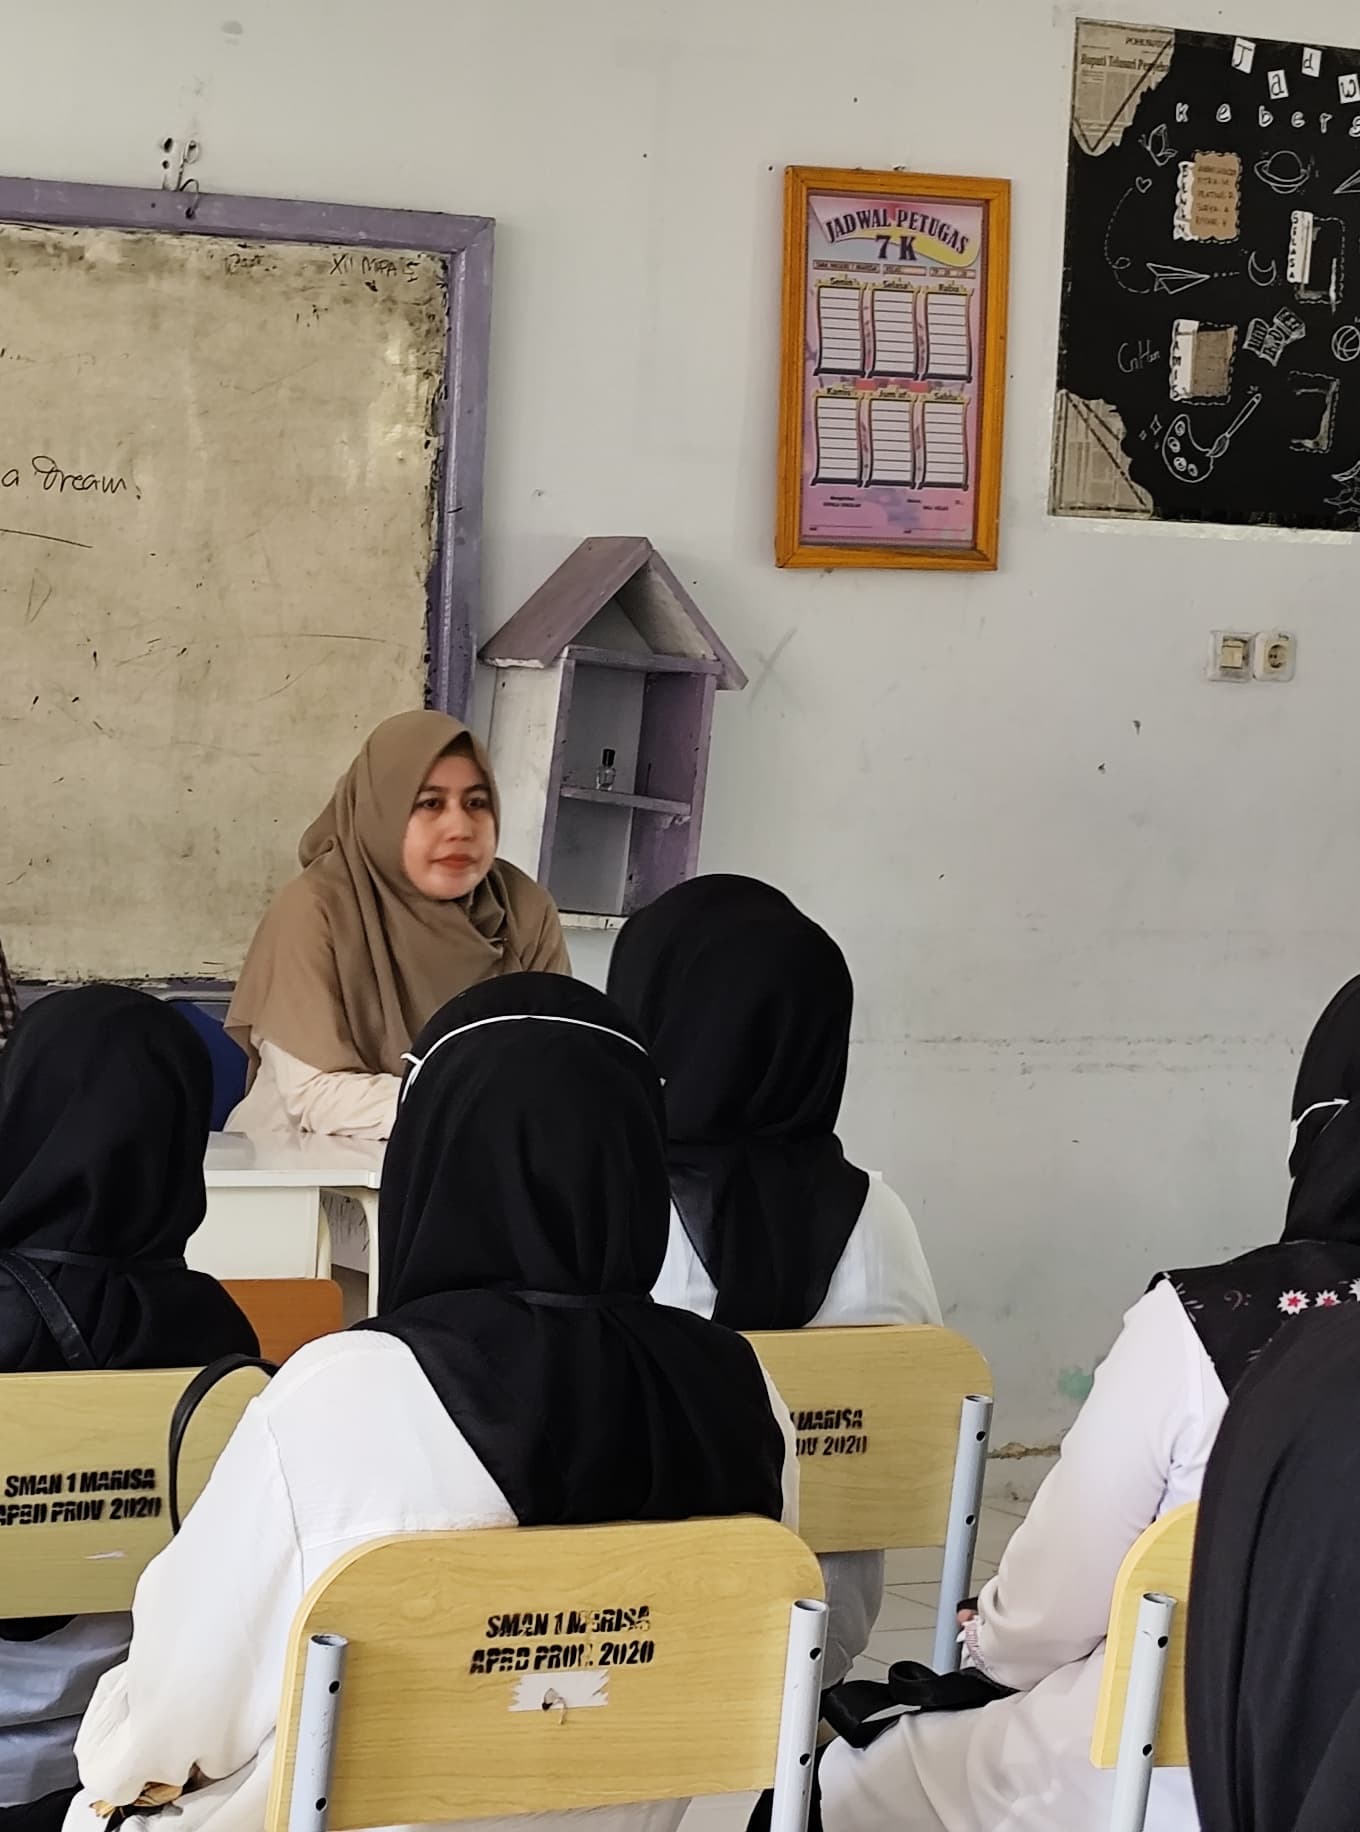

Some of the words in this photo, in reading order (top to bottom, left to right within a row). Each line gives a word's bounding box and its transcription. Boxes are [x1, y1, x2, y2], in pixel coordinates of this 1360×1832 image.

[825, 207, 892, 244] JADWAL
[896, 209, 970, 256] PETUGAS
[874, 234, 891, 260] 7
[898, 235, 917, 261] K
[1, 469, 20, 488] a
[797, 1408, 863, 1431] MARISA
[822, 1435, 868, 1456] 2020
[4, 1473, 63, 1498] SMAN
[66, 1472, 76, 1493] 1
[79, 1468, 156, 1493] MARISA
[50, 1499, 105, 1523] PROV
[109, 1496, 163, 1520] 2020
[485, 1613, 549, 1638] SMAN
[553, 1611, 564, 1635] 1
[469, 1646, 530, 1674] APBD
[598, 1640, 655, 1666] 2020
